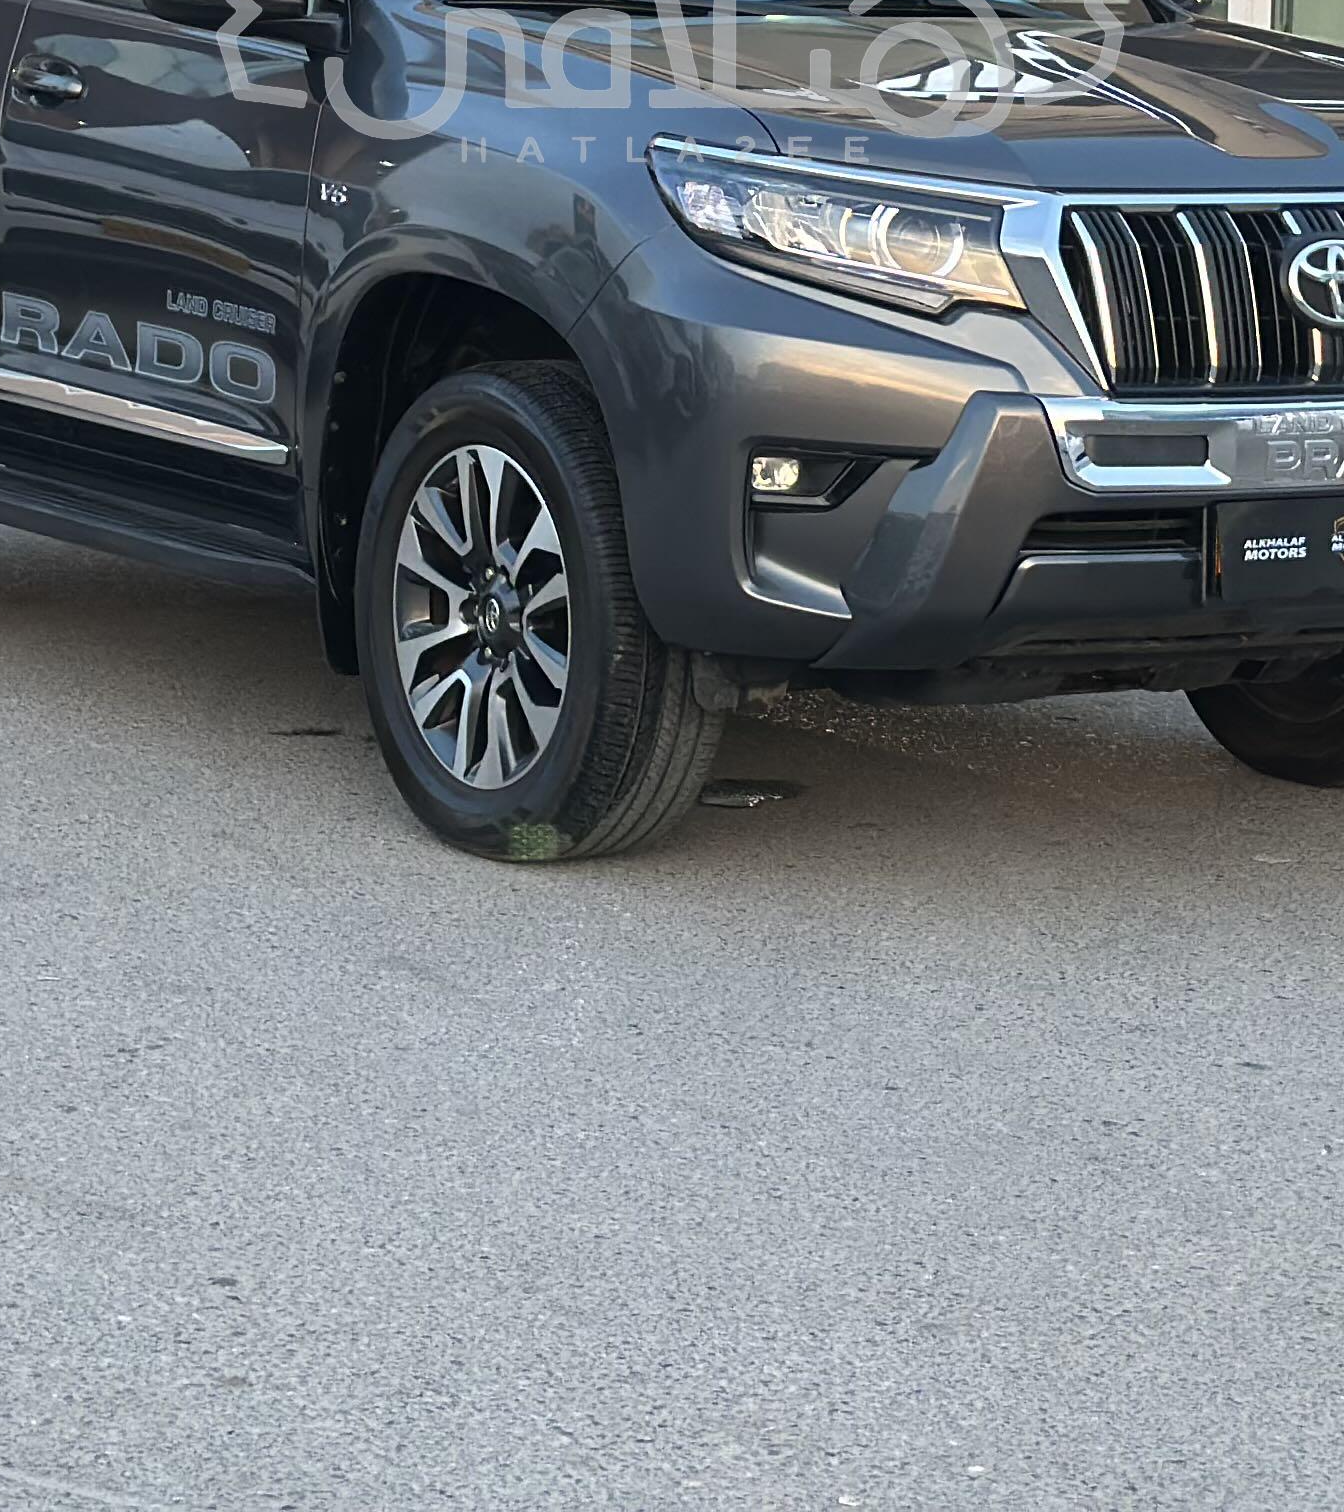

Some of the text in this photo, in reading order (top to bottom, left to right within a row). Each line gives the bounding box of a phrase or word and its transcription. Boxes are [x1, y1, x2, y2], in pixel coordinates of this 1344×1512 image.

[166, 289, 276, 336] LAND CRUISER
[1243, 536, 1306, 549] ALKHALAF
[1243, 546, 1308, 562] MOTORS
